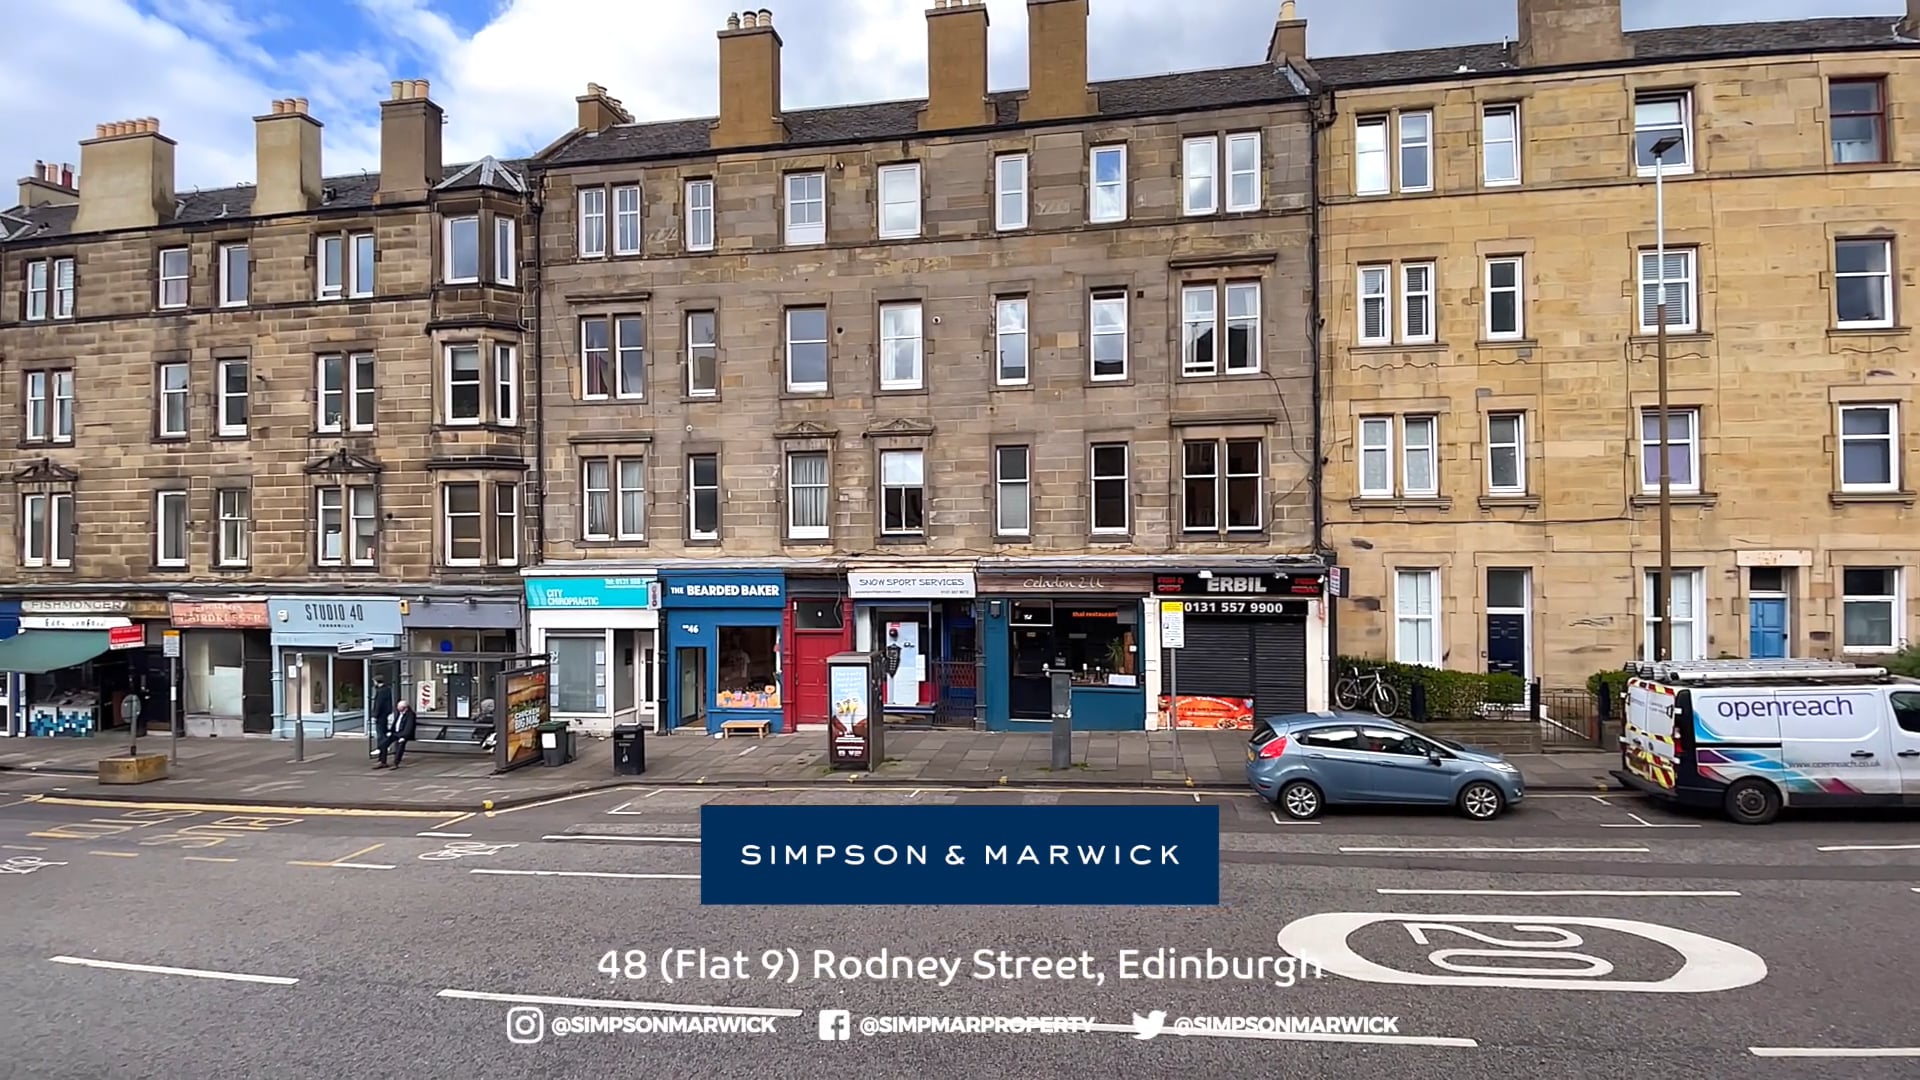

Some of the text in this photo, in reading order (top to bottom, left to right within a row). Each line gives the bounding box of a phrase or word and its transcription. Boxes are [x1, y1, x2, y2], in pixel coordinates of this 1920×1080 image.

[1023, 576, 1076, 588] Celadon
[1207, 577, 1267, 592] ERBIL
[546, 589, 562, 597] CITY
[687, 585, 739, 596] BEARDED
[741, 585, 779, 596] BAKER
[31, 601, 123, 609] FISHMONGER
[547, 597, 599, 605] CHIROPRACTIC
[305, 604, 364, 621] STUDIO 40
[1184, 602, 1215, 613] 0131
[1221, 603, 1245, 613] 557
[1250, 603, 1283, 614] 9900
[687, 625, 699, 633] 46
[1717, 696, 1853, 720] openreach
[515, 717, 528, 729] BIG
[1788, 760, 1881, 769] www.openreach.co.uk
[1400, 922, 1615, 978] 20
